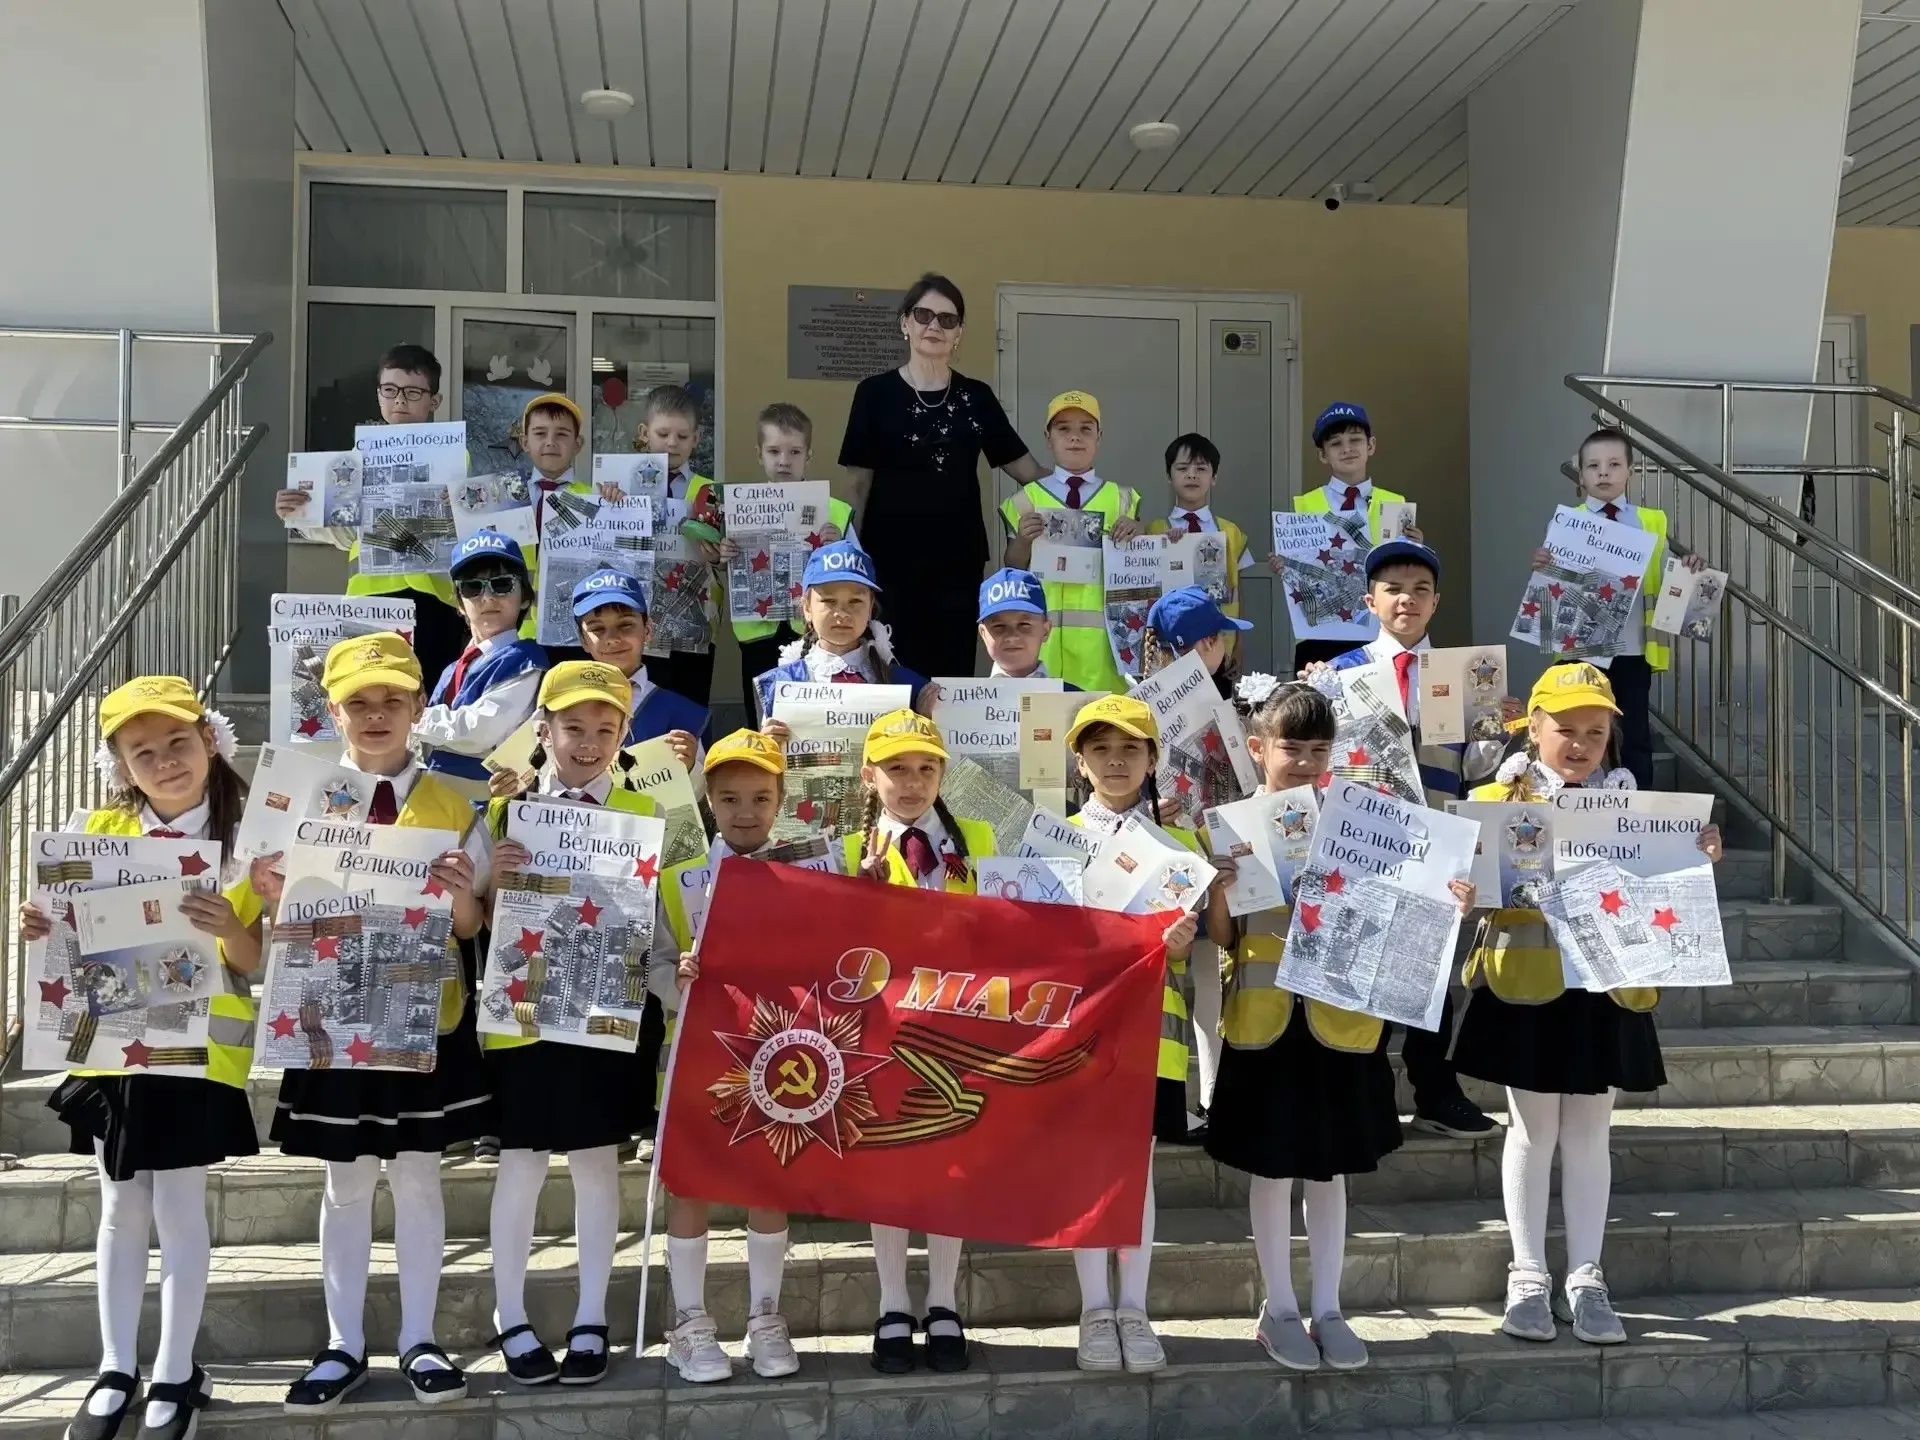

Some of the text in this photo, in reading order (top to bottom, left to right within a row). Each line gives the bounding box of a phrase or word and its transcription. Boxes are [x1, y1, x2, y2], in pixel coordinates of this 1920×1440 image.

[356, 439, 365, 451] С
[363, 451, 414, 467] еликой
[733, 487, 785, 500] С днём
[736, 501, 795, 515] Великой
[585, 517, 645, 532] Великой
[728, 512, 785, 527] Победы!
[1275, 513, 1319, 526] С днём
[1555, 513, 1603, 535] С днём
[544, 532, 601, 551] Победы!
[1275, 525, 1326, 539] Великой
[461, 536, 507, 554] ЮИД
[1279, 536, 1327, 551] Победы!
[1586, 534, 1643, 562] Великой
[823, 552, 868, 577] ЮИД
[1124, 555, 1161, 568] Велик
[585, 575, 631, 592] ЮИД
[1109, 573, 1156, 586] Победы!
[987, 580, 1030, 605] ЮИД
[274, 599, 416, 620] С днём Великой
[780, 683, 843, 702] С днём
[937, 686, 998, 704] С днём
[1156, 669, 1204, 715] Великой
[826, 711, 886, 727] Велик
[948, 729, 1017, 748] Победы!
[1343, 786, 1412, 827] С днём
[1556, 793, 1630, 813] С днём
[517, 804, 591, 829] С днём
[1617, 816, 1702, 834] Великой
[297, 821, 371, 848] С днём
[1032, 813, 1046, 830] С
[1045, 824, 1099, 858] днём
[1340, 820, 1426, 857] Великой
[40, 837, 129, 860] С днём
[559, 831, 641, 859] Великой
[1560, 840, 1642, 861] Победы!
[339, 849, 429, 880] Великой
[534, 850, 593, 873] беды!
[1322, 837, 1404, 880] Победы!
[680, 871, 694, 888] С
[288, 888, 377, 922] Победы!
[827, 946, 1084, 1029] 9 МАЯ
[753, 1032, 838, 1111] ОТЕЧЕСТВЕННАЯ
